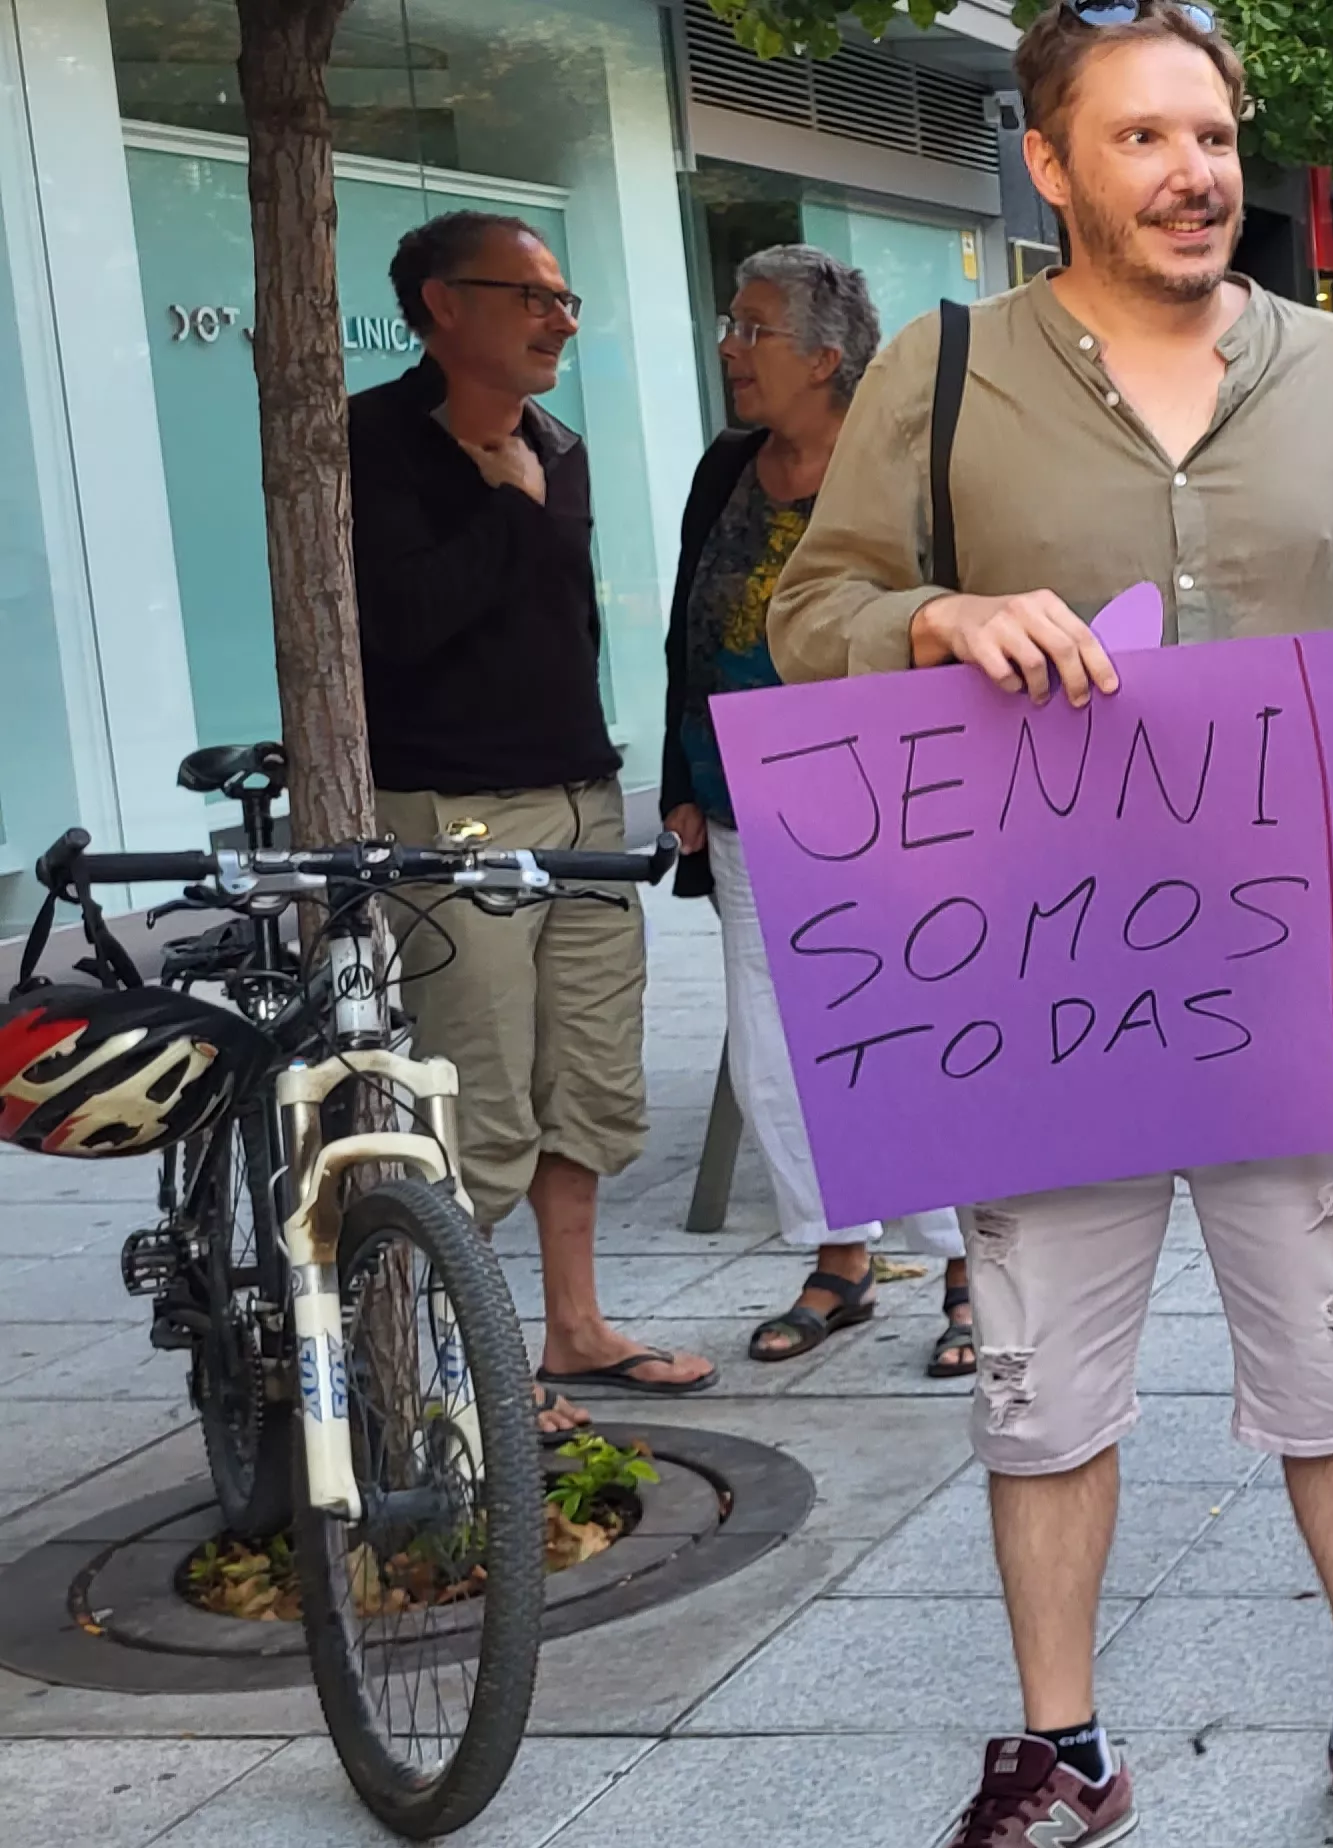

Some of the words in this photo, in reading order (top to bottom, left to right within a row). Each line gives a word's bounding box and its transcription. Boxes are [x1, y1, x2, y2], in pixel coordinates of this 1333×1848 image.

[761, 704, 1283, 862] JENNI
[790, 875, 1310, 1011] SOMOS
[815, 988, 1253, 1089] TODAS
